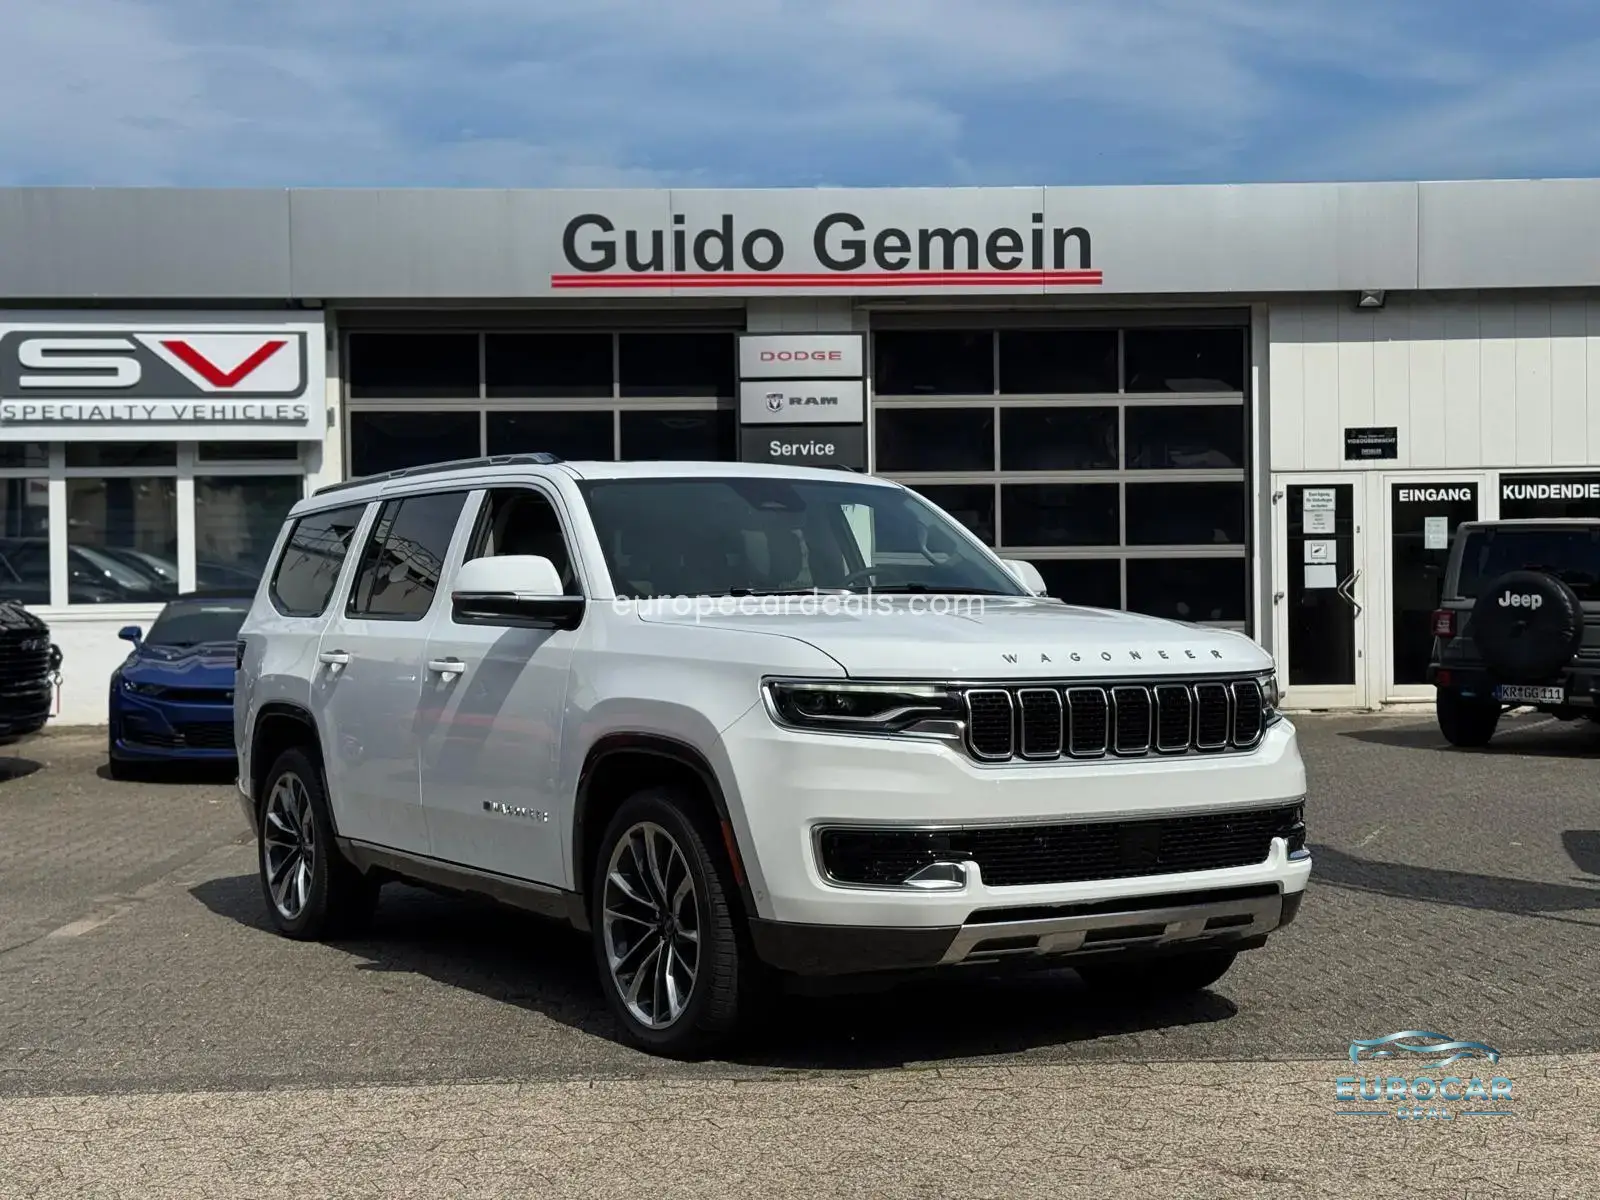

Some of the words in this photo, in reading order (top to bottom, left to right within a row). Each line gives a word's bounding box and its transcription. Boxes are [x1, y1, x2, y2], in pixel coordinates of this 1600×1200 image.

[562, 213, 785, 272] Guido
[813, 212, 1092, 271] Gemein
[18, 338, 289, 388] SV
[760, 350, 842, 361] DODGE
[788, 396, 838, 405] RAM
[2, 404, 157, 420] SPECIALTY
[171, 404, 307, 420] VEHICLES
[769, 440, 835, 456] Service
[1399, 488, 1471, 502] EINGANG
[1498, 590, 1543, 610] Jeep
[1002, 649, 1223, 664] WAGONEER
